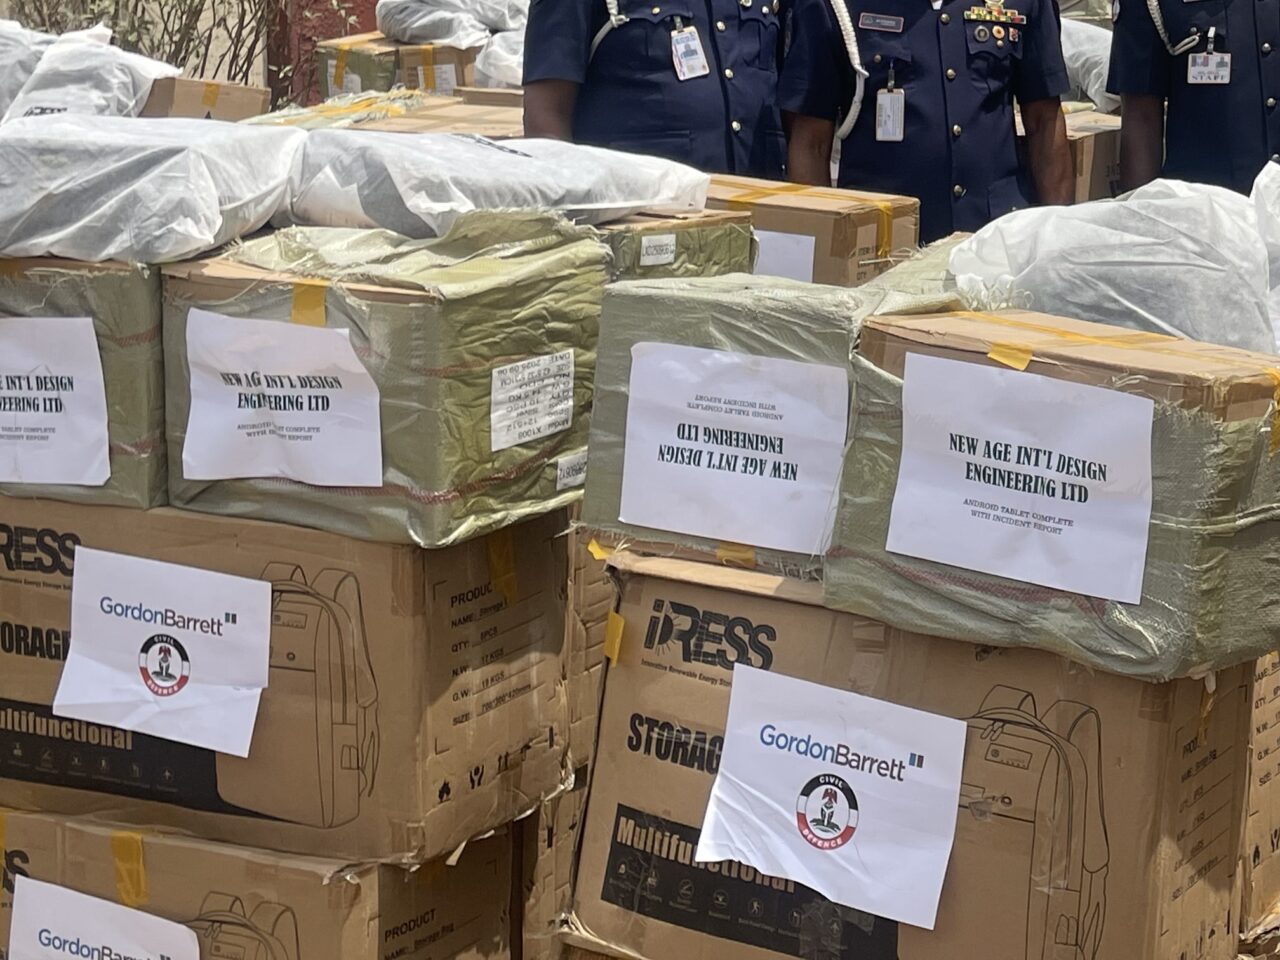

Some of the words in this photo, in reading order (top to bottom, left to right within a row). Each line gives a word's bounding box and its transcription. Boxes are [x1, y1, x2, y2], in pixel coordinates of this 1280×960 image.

[5, 375, 33, 391] INT'L
[36, 375, 74, 392] DESIGN
[244, 371, 261, 388] AG
[263, 374, 297, 389] INT'L
[297, 375, 343, 389] DESIGN
[43, 397, 63, 413] LTD
[308, 395, 330, 411] LTD
[687, 402, 723, 413] COMPLETE
[694, 394, 722, 404] REPORT
[723, 398, 757, 409] INCIDENT
[758, 402, 776, 411] WITH
[724, 408, 750, 417] TABLET
[751, 411, 784, 421] ANDROID
[676, 422, 699, 442] LTD
[703, 426, 784, 455] ENGINEERING
[657, 444, 702, 467] DESIGN
[706, 451, 739, 473] INT'L
[949, 433, 979, 456] NEW
[982, 440, 1012, 463] AGE
[1015, 445, 1054, 471] INT'L
[1055, 453, 1107, 482] DESIGN
[740, 457, 768, 477] AGE
[769, 460, 799, 481] NEW
[965, 461, 1056, 498] ENGINEERING
[1061, 481, 1089, 504] LTD
[963, 498, 999, 512] ANDROID
[1001, 506, 1030, 519] TABLET
[1032, 512, 1074, 527] COMPLETE
[970, 509, 991, 521] WITH
[992, 514, 1032, 529] INCIDENT
[1033, 522, 1063, 536] REPORT
[450, 581, 493, 608] PRODUC
[100, 596, 223, 637] GordonBarrett
[698, 672, 718, 686] Energy
[627, 712, 725, 775] STORAG
[760, 724, 906, 781] GordonBarrett
[819, 775, 844, 789] CIVIL
[802, 828, 843, 848] DEFENCE
[384, 908, 437, 943] PRODUCT
